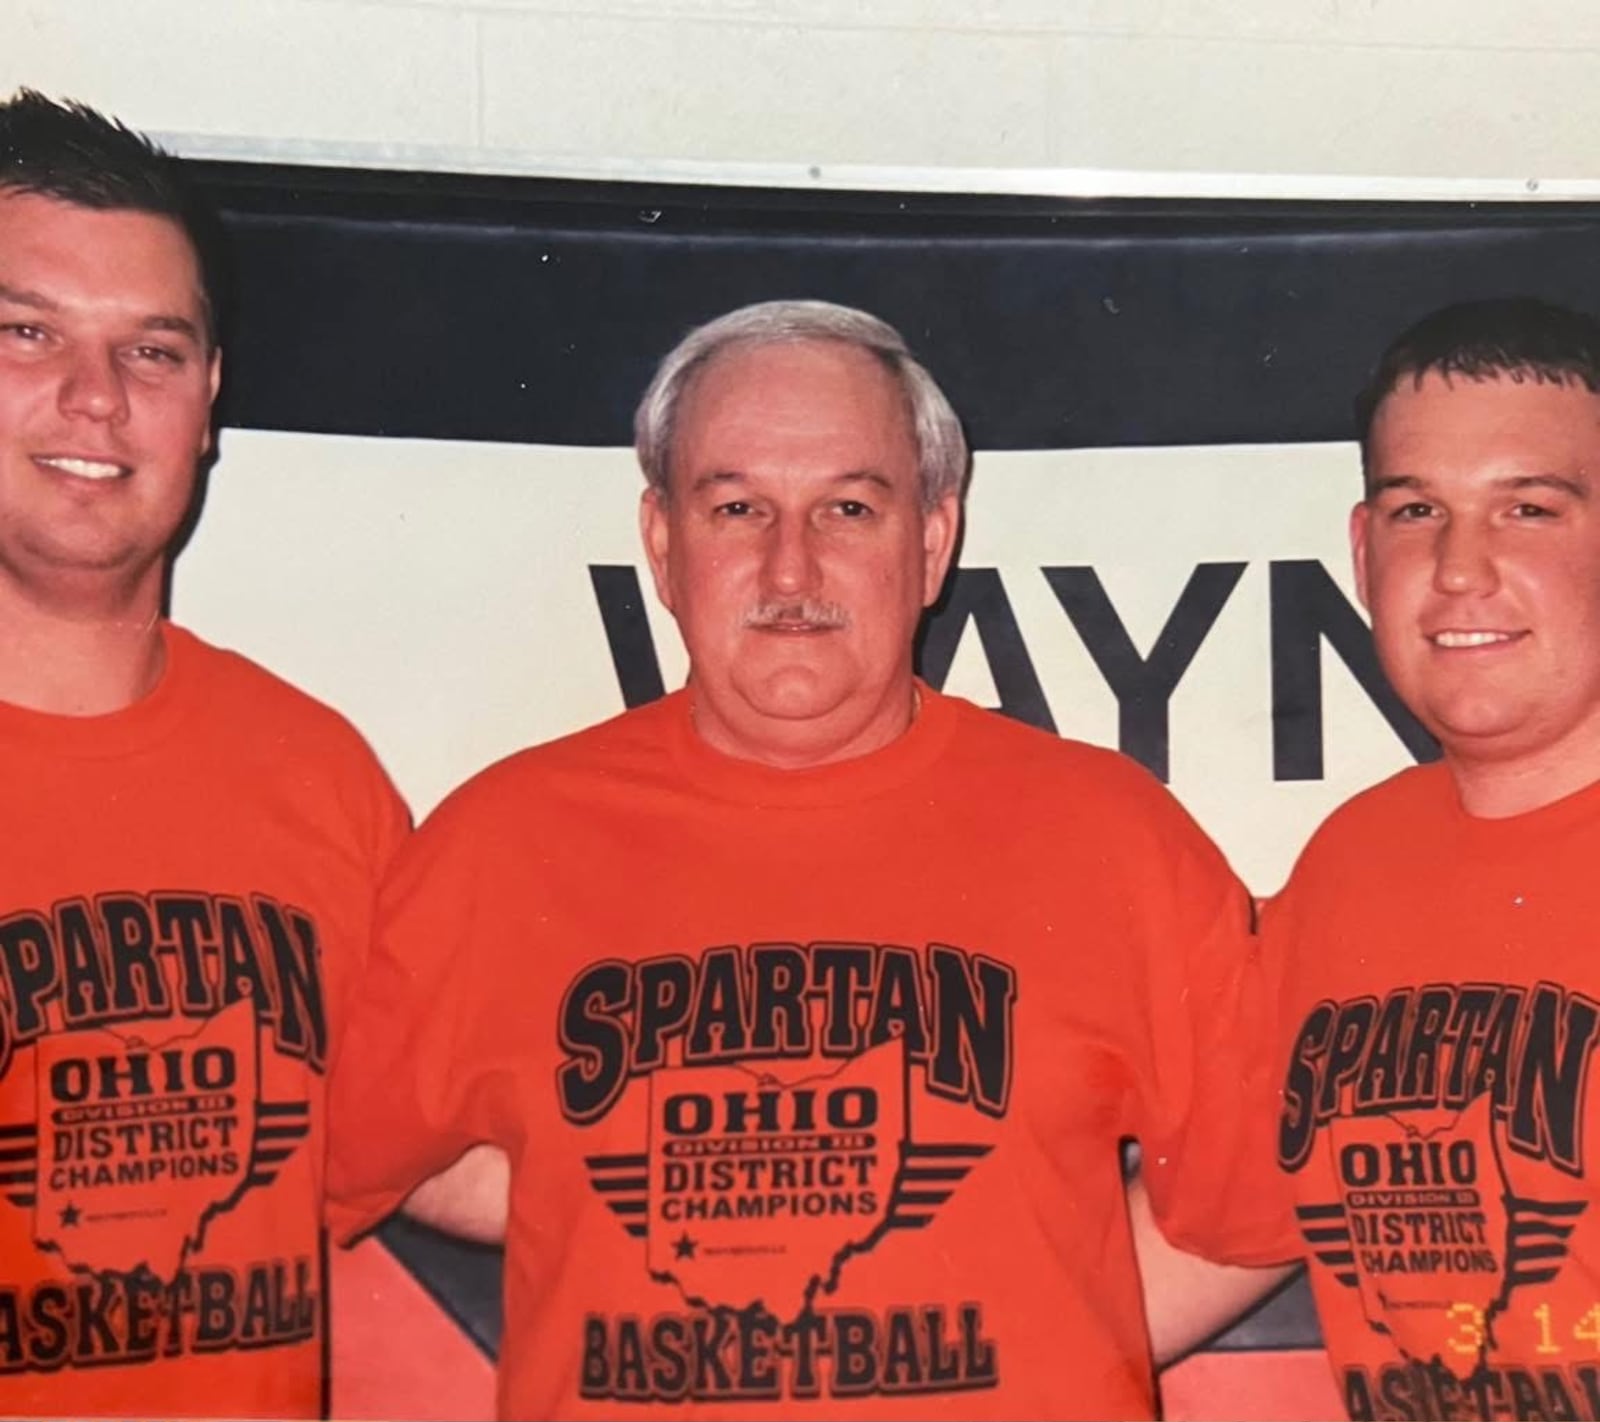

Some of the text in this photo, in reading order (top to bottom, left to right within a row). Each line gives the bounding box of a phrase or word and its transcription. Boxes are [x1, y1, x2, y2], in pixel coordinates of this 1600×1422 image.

[0, 889, 327, 1075] PARTAN
[555, 941, 1018, 1127] SPARTAN
[49, 1045, 236, 1104] OHIO
[1278, 980, 1600, 1179] SPARTAN
[662, 1086, 879, 1137] OHIO
[53, 1115, 238, 1163] DISTRICT
[670, 1136, 820, 1156] DIVISION
[50, 1151, 239, 1191] CHAMPIONS
[663, 1154, 878, 1194] DISTRICT
[1340, 1139, 1478, 1188] OHIO
[660, 1191, 878, 1221] CHAMPIONS
[1350, 1191, 1450, 1207] DIVISION
[1351, 1211, 1486, 1246] DISTRICT
[579, 1302, 1000, 1403] BASKETBALL
